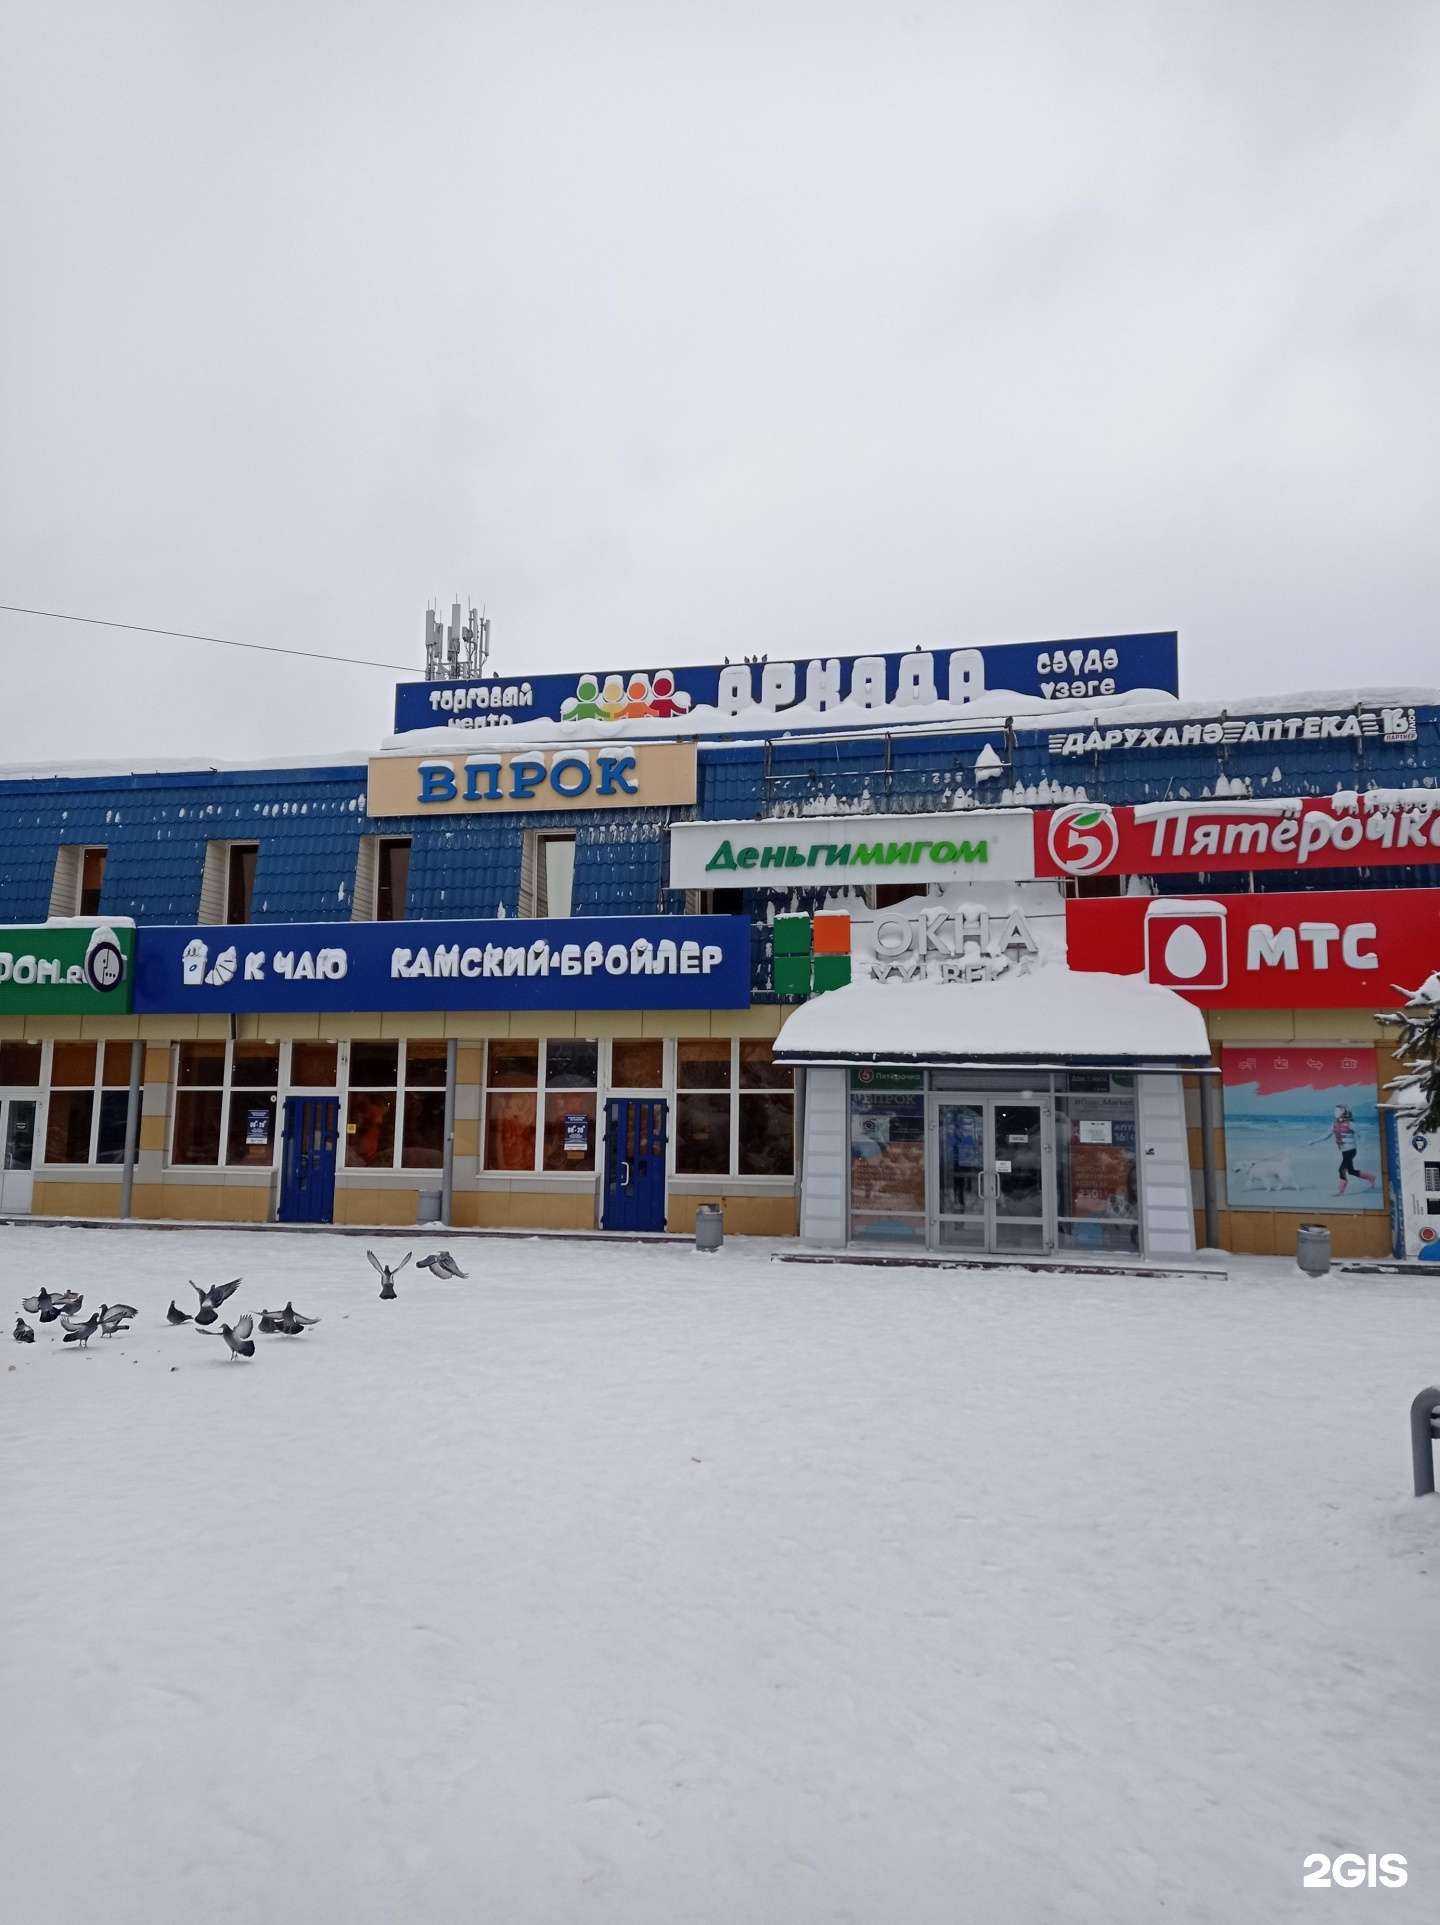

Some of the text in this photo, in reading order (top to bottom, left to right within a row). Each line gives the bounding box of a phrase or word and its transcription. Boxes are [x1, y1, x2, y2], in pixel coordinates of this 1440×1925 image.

[1062, 714, 1363, 755] ДАРУХАНӘ АПТЕКА
[417, 756, 639, 802] ВПРОК
[705, 839, 989, 872] Деньгимигом
[871, 906, 1040, 958] ОКНА
[1246, 922, 1379, 971] МТС
[244, 948, 348, 980] К ЧАЮ
